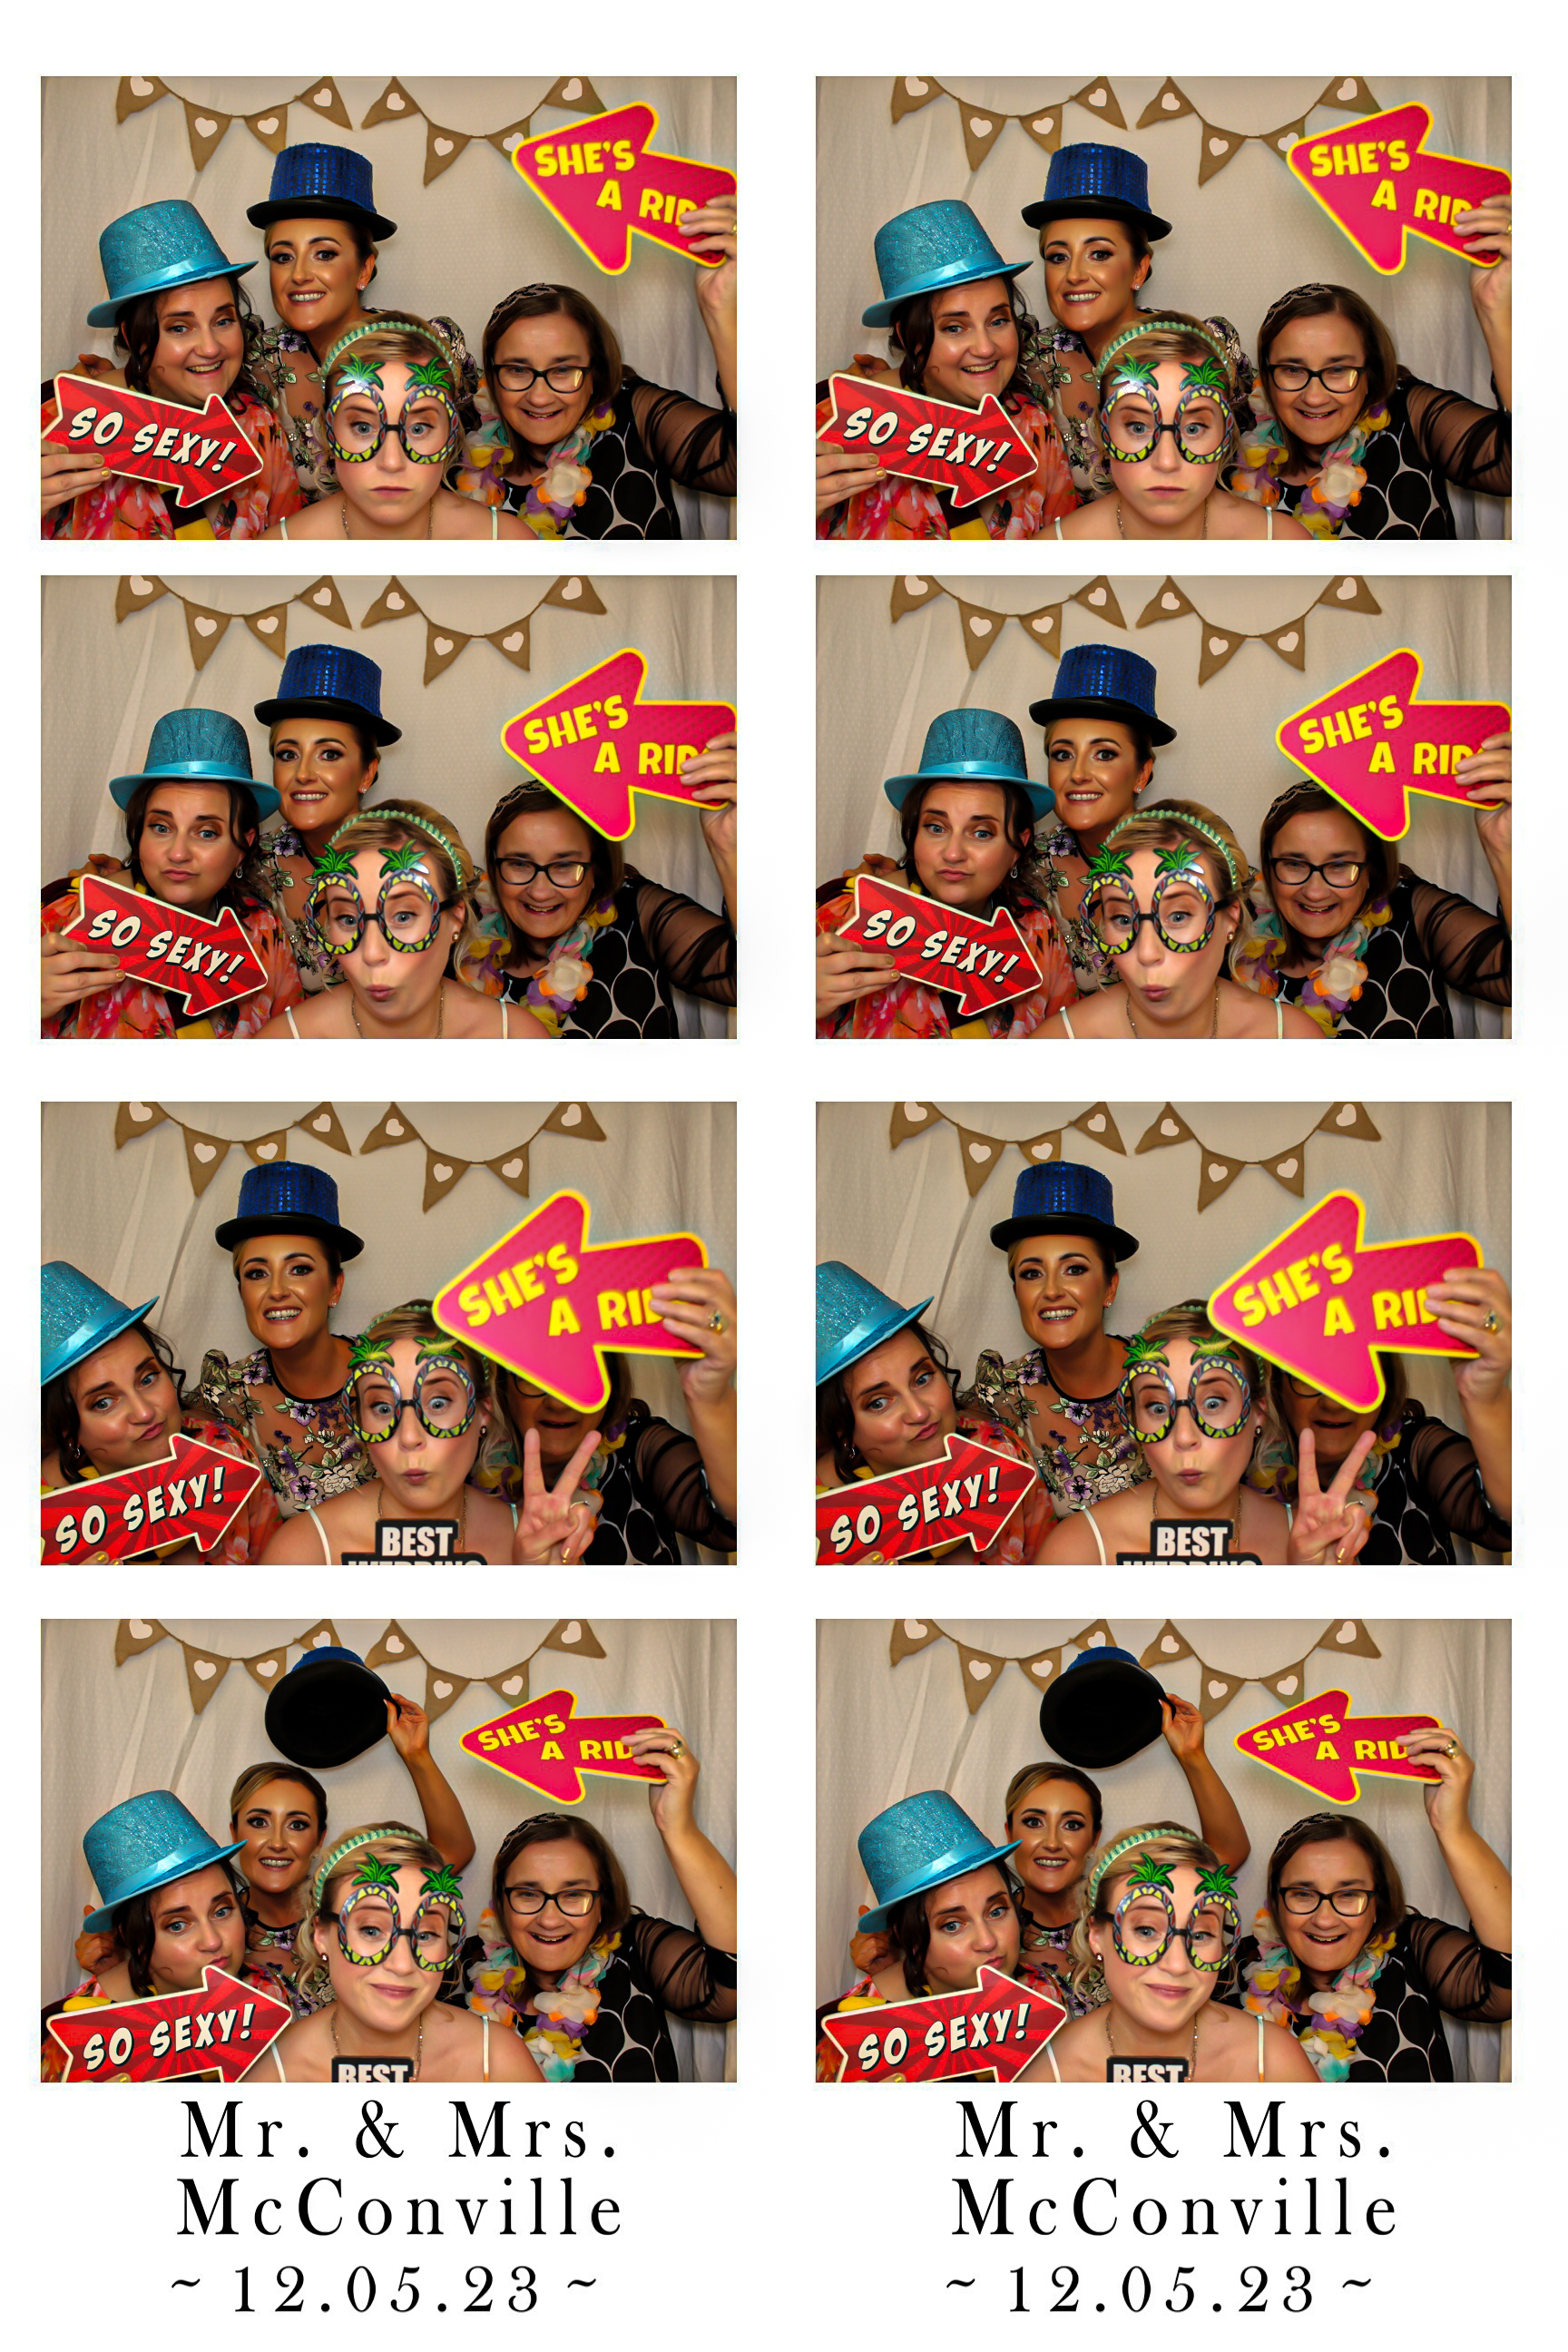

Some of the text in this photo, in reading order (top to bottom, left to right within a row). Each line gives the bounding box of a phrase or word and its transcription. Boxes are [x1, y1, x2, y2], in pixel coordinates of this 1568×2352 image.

[534, 140, 636, 178] SHE'S
[1308, 140, 1411, 178] SHE'S
[595, 179, 707, 227] A RID
[1370, 179, 1482, 227] A RID
[68, 406, 238, 475] SO SEXY!
[843, 406, 1013, 475] SO SEXY!
[523, 694, 630, 755] SHE'S
[1298, 694, 1405, 755] SHE'S
[593, 741, 709, 775] A RID
[1368, 741, 1484, 775] A RID
[87, 908, 246, 985] SO SEXY!
[862, 908, 1021, 985] SO SEXY!
[456, 1241, 579, 1328] SHE'S
[1231, 1241, 1354, 1328] SHE'S
[547, 1288, 668, 1338] A RID
[1322, 1288, 1443, 1338] A RID
[54, 1466, 226, 1555] SO SEXY!
[829, 1466, 1001, 1555] SO SEXY!
[381, 1526, 454, 1557] BEST
[1156, 1526, 1229, 1557] BEST
[476, 1713, 567, 1752] SHE'S
[540, 1740, 634, 1761] A RID
[1251, 1713, 1342, 1752] SHE'S
[1315, 1740, 1409, 1761] A RID
[83, 2003, 257, 2073] SO SEXY!
[858, 2003, 1032, 2073] SO SEXY!
[338, 2063, 409, 2082] BEST
[1112, 2063, 1184, 2082] BEST
